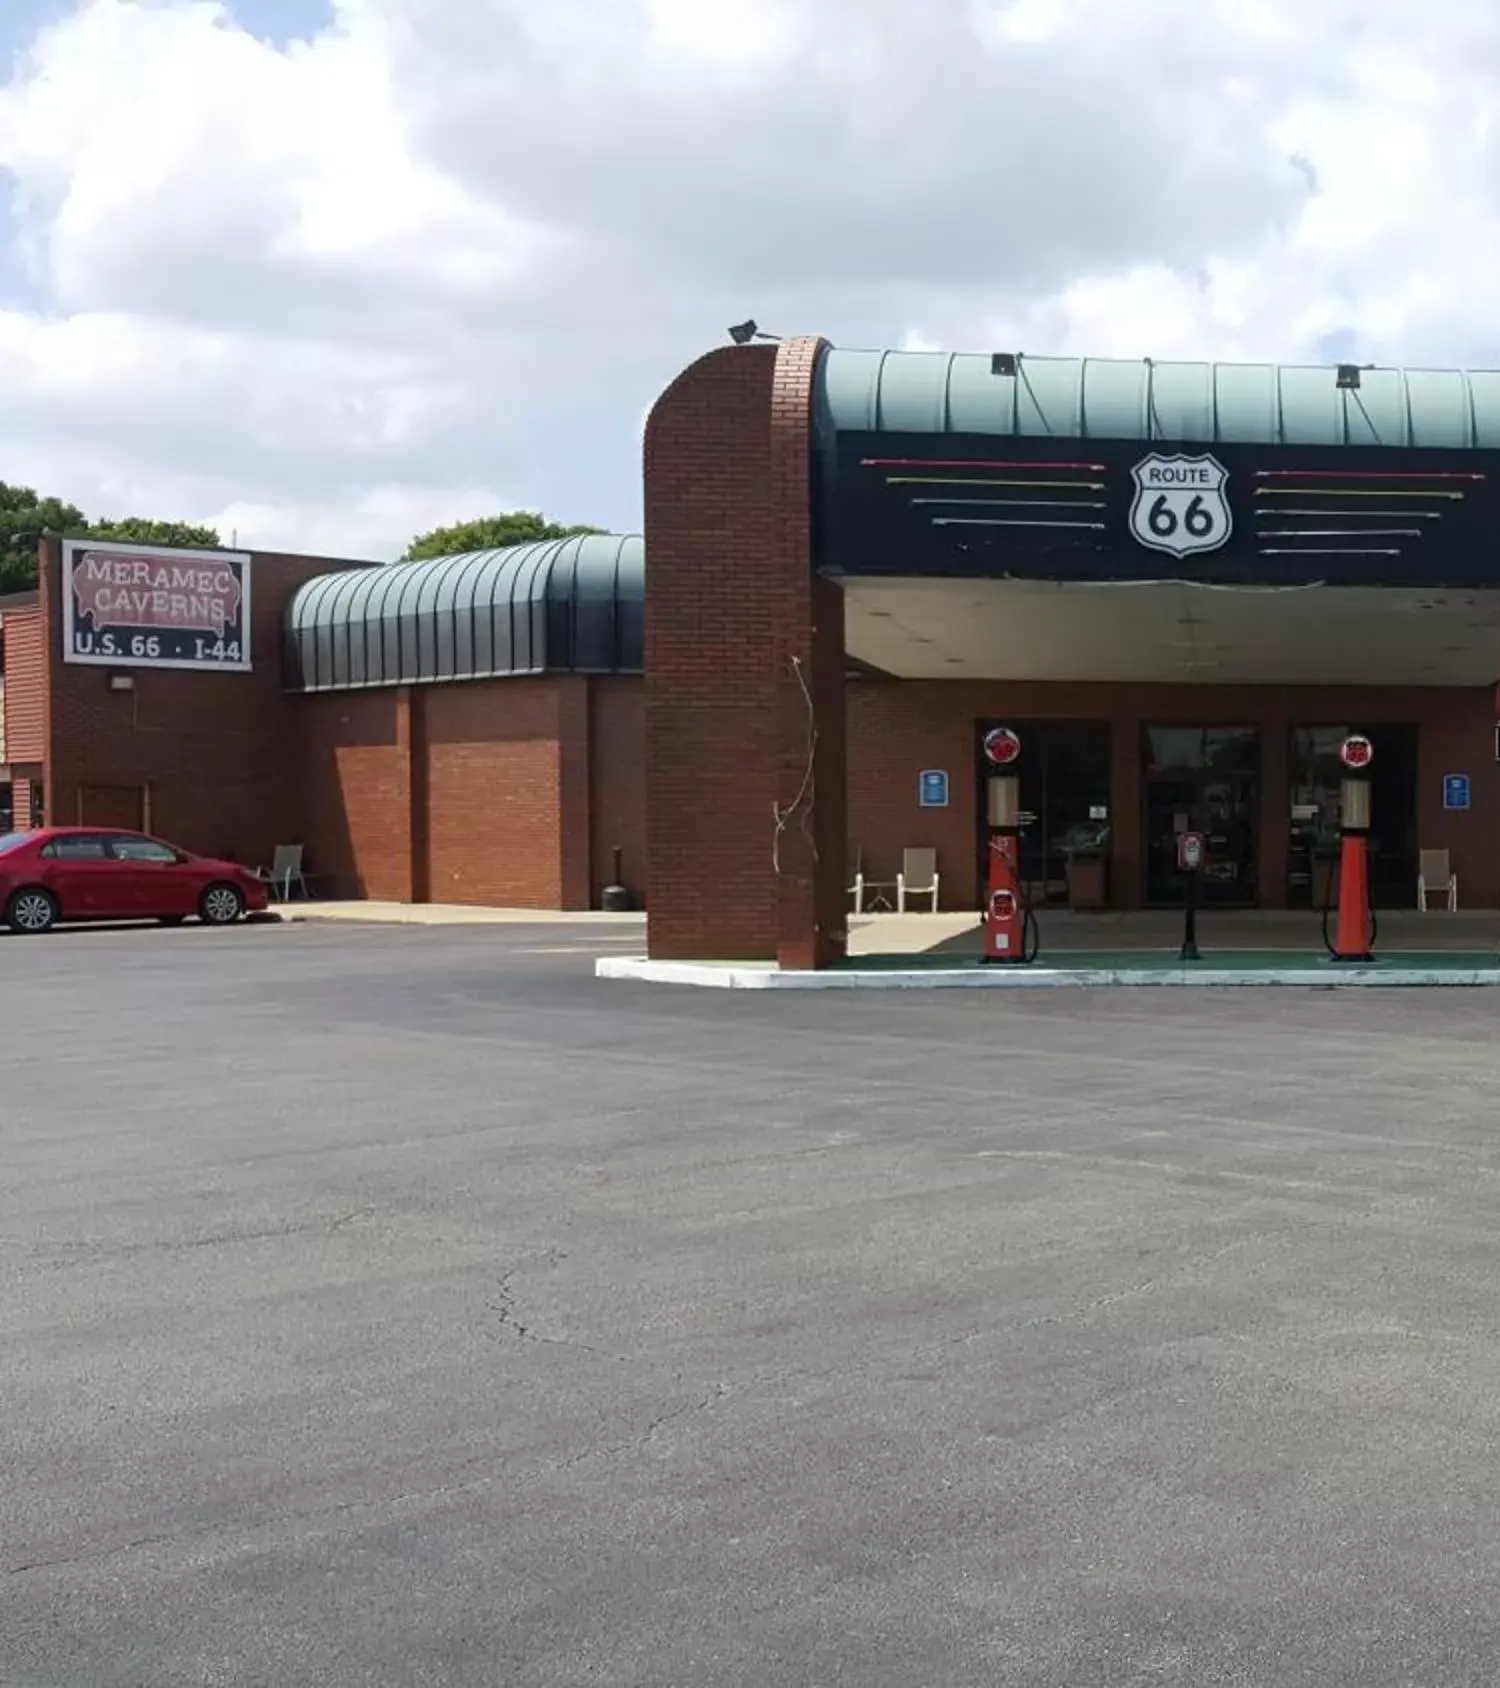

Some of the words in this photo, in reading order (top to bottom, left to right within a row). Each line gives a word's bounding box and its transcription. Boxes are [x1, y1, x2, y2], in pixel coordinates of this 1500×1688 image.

[1149, 467, 1210, 483] ROUTE
[1148, 494, 1215, 538] 66
[86, 558, 231, 593] MERAMEC
[94, 587, 225, 622] CAVERNS
[75, 631, 123, 655] U.S.
[131, 635, 161, 658] 66
[195, 639, 241, 660] I-44
